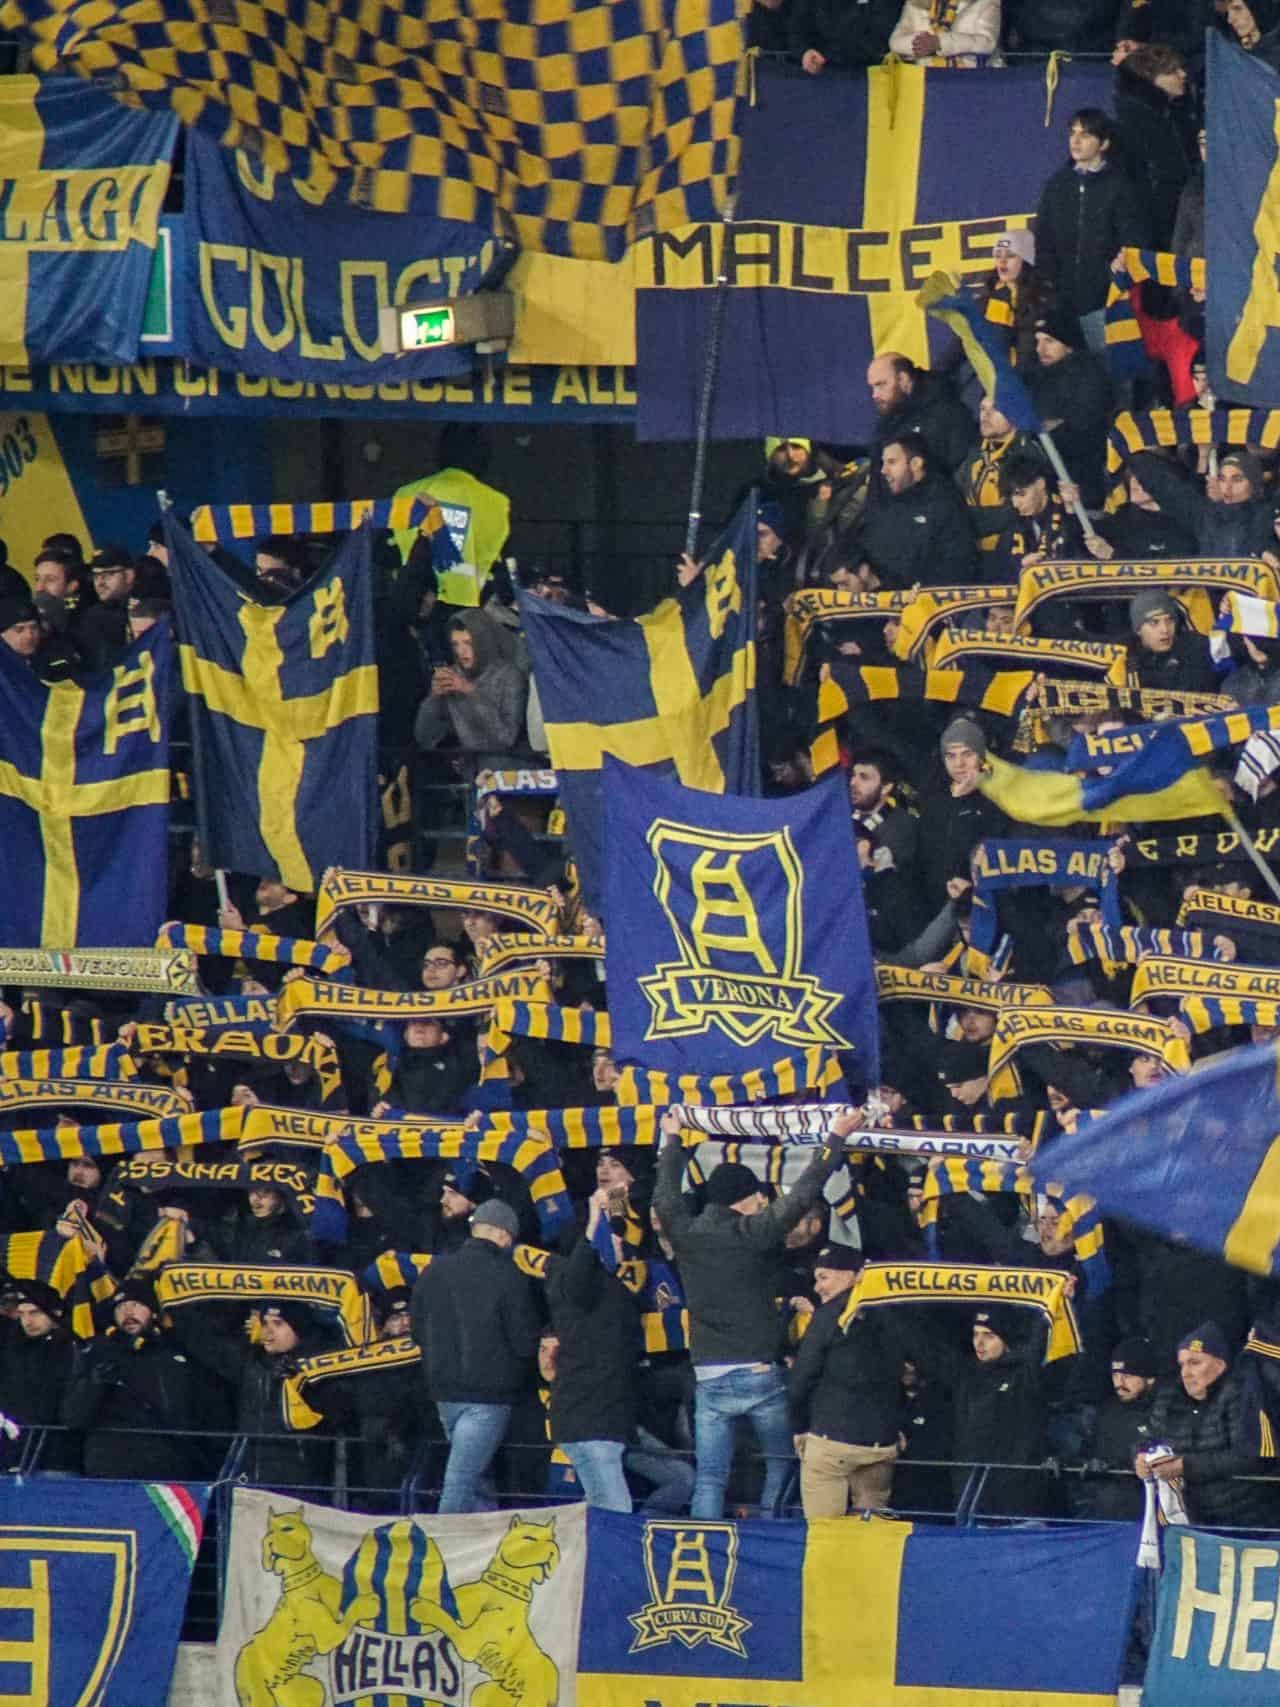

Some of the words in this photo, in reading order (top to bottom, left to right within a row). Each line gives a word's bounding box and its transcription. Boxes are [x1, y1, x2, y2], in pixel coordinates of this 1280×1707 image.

[551, 366, 637, 405] ALL
[1033, 566, 1157, 588] HELLAS
[1169, 564, 1267, 586] ARMY
[950, 628, 1040, 647] HELLAS
[325, 876, 450, 898] HELLAS
[1189, 892, 1275, 921] HELLAS
[313, 982, 436, 1007] HELLAS
[450, 976, 539, 1003] ARMY
[960, 978, 1032, 1004] ARMY
[1147, 965, 1237, 990] HELLAS
[689, 977, 793, 1011] VERONA
[997, 1015, 1085, 1043] HELLAS
[1096, 1023, 1177, 1048] ARMY
[917, 1141, 1019, 1158] ARMY
[169, 1271, 262, 1294] HELLAS
[273, 1272, 347, 1299] ARMY
[884, 1270, 978, 1293] HELLAS
[988, 1273, 1058, 1298] ARMY
[655, 1608, 698, 1627] CURVA
[699, 1608, 725, 1627] SUD
[334, 1633, 460, 1697] HELLAS
